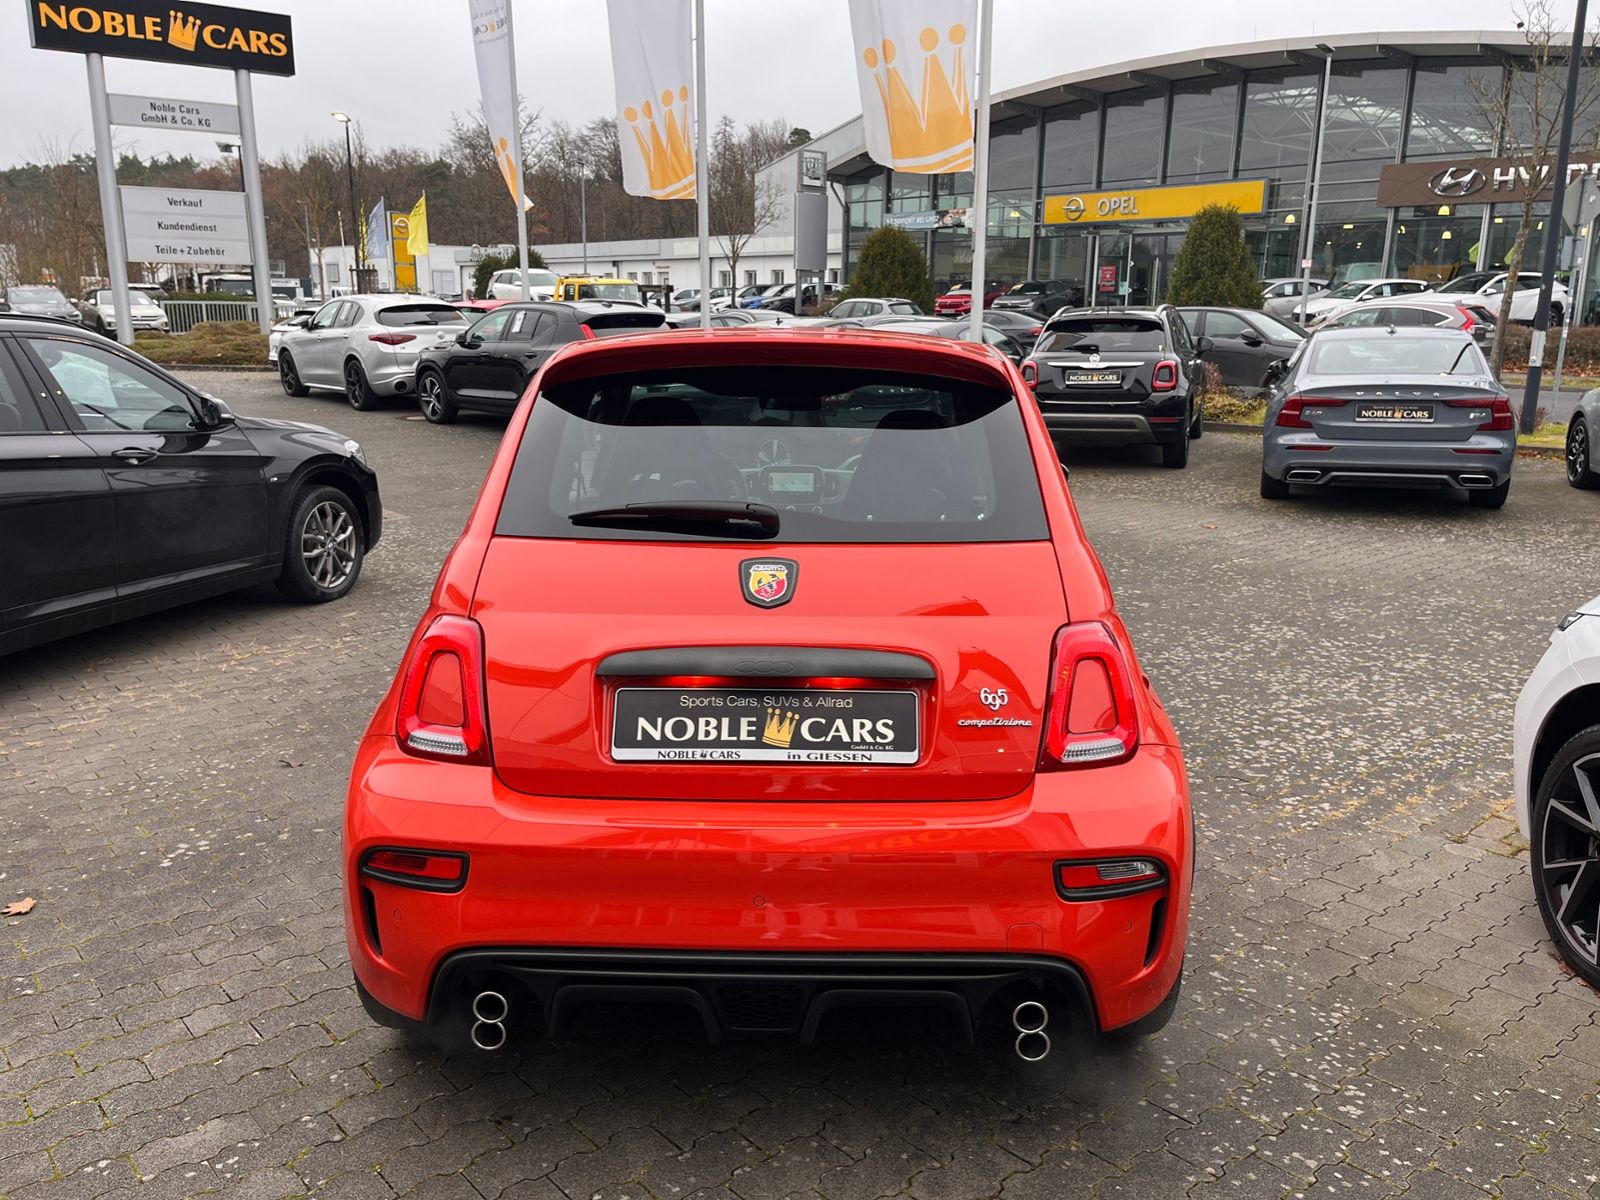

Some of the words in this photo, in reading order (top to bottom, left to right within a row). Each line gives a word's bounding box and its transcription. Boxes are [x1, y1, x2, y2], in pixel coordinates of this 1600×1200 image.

[38, 2, 163, 42] NOBLE
[202, 24, 288, 57] CARS
[150, 102, 176, 113] Noble
[179, 105, 200, 115] Cars
[141, 113, 168, 124] GmbH
[170, 115, 178, 124] &
[181, 116, 196, 126] Co.
[198, 118, 211, 127] KG
[167, 197, 203, 207] Verkauf
[1097, 195, 1139, 216] OPEL
[157, 221, 217, 232] Kundendienst
[1361, 410, 1393, 418] NOBLE
[679, 695, 724, 708] Sports
[726, 696, 761, 707] Cars,
[763, 696, 800, 707] SUVs
[802, 697, 813, 707] &
[816, 697, 853, 708] Allrad
[980, 687, 1008, 711] 695
[957, 717, 1033, 728] competizione
[636, 716, 757, 741] NOBLE
[800, 717, 895, 743] CARS
[657, 750, 698, 760] NOBLE
[709, 751, 741, 760] CARS
[787, 751, 801, 760] in
[807, 752, 872, 761] GIESSEN
